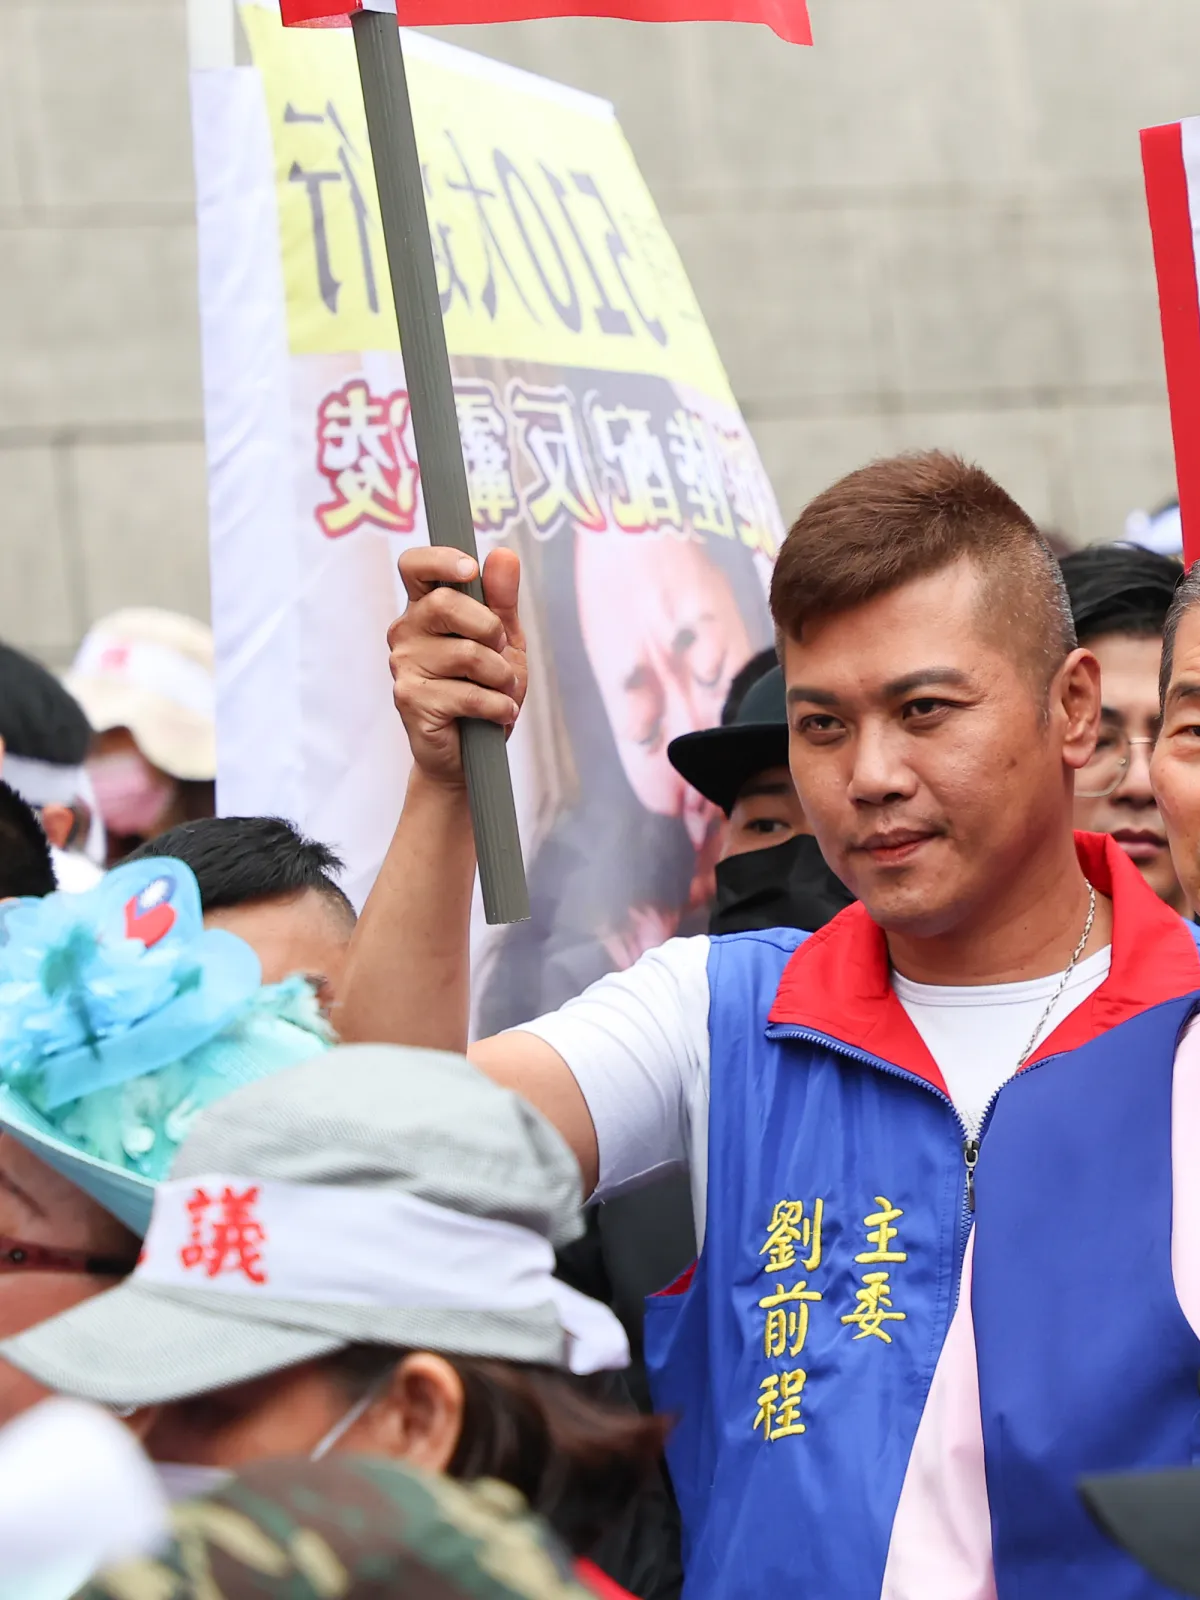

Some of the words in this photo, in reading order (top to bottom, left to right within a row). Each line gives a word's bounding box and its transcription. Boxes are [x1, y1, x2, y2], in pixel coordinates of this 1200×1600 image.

[181, 1187, 265, 1285] 議
[841, 1196, 908, 1344] 主委
[753, 1197, 824, 1442] 劉前程
